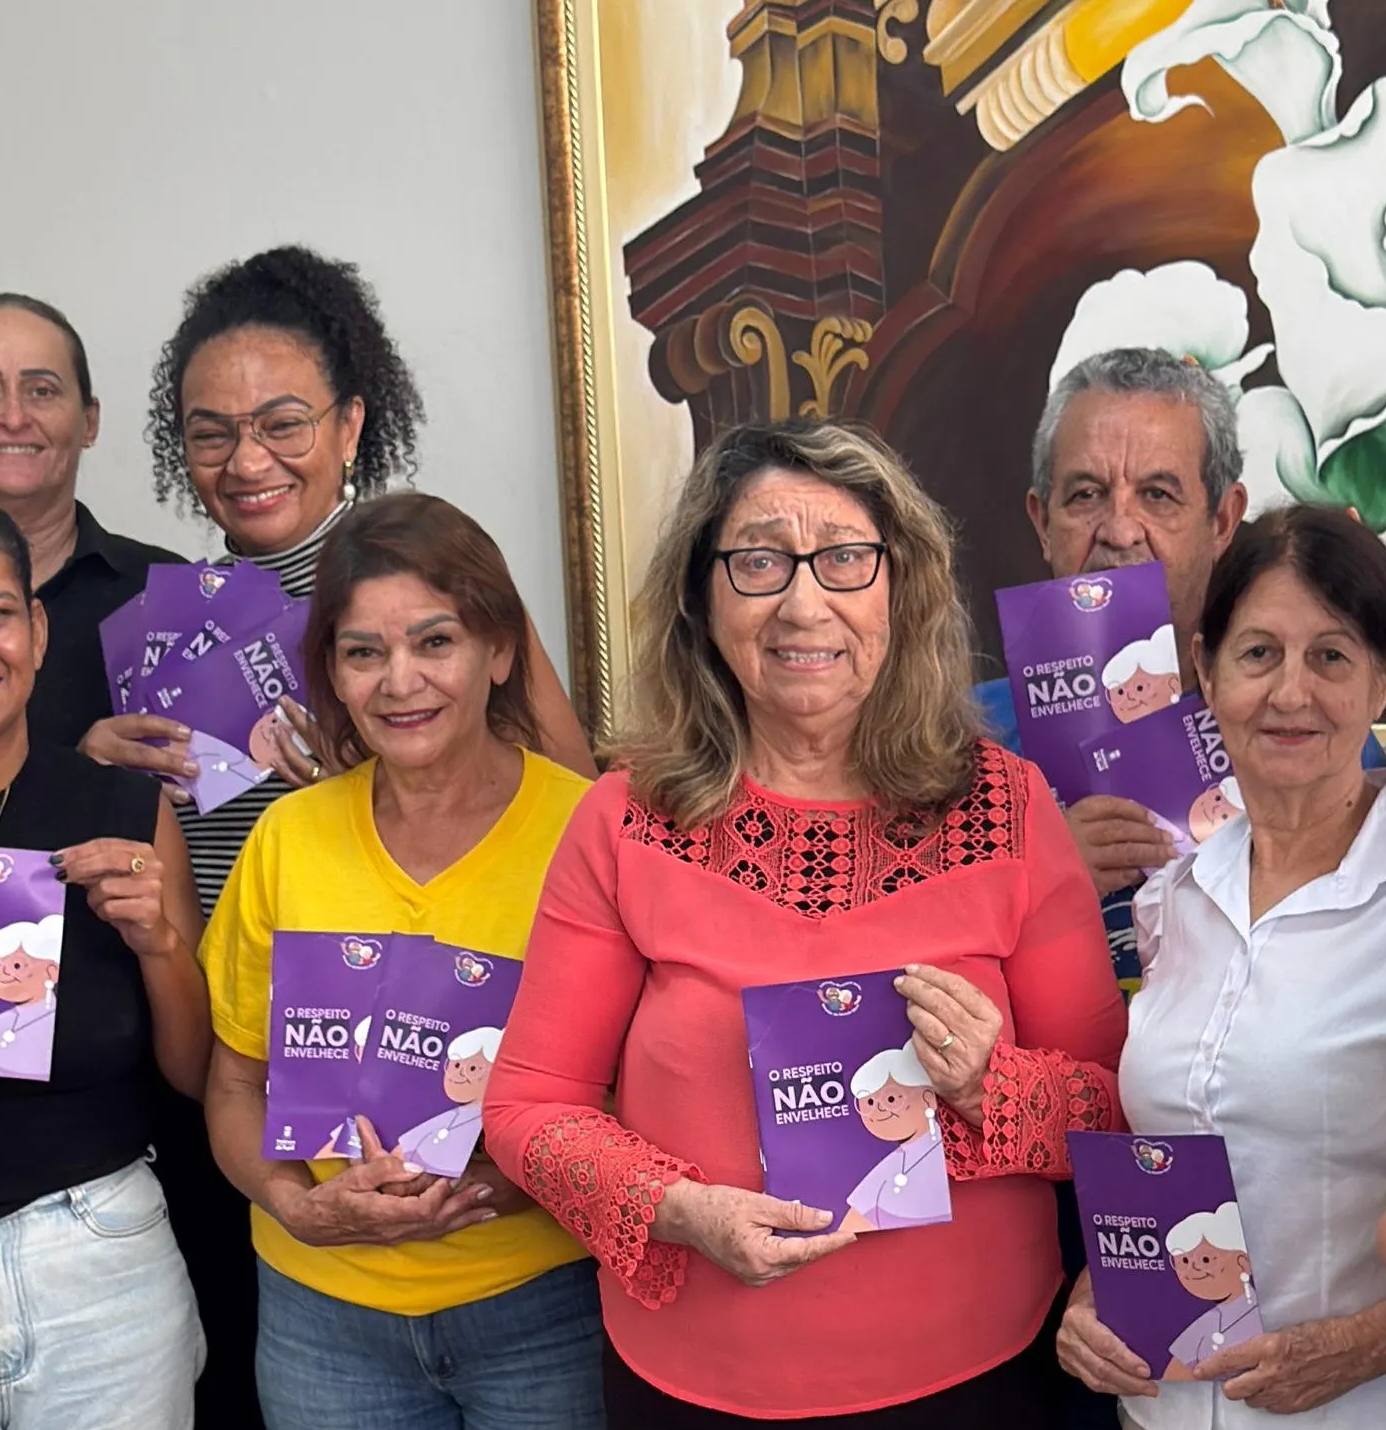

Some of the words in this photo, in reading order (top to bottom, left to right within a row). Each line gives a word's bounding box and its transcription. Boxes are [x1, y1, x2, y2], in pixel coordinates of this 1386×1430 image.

[1023, 666, 1034, 677] O
[1037, 655, 1094, 674] RESPEITO
[1027, 671, 1096, 705] NÃO
[1030, 695, 1101, 718] ENVELHECE
[1182, 714, 1212, 782] ENVELHECE
[285, 1008, 294, 1018] O
[297, 1008, 351, 1020] RESPEITO
[386, 1009, 396, 1020] O
[398, 1012, 450, 1032] RESPEITO
[285, 1019, 348, 1047] NÃO
[381, 1026, 443, 1057] NÃO
[284, 1047, 349, 1060] ENVELHECE
[377, 1050, 440, 1071] ENVELHECE
[769, 1070, 780, 1082] O
[783, 1062, 843, 1080] RESPEITO
[773, 1077, 845, 1111] NÃO
[775, 1104, 849, 1125] ENVELHECE
[1093, 1214, 1102, 1226] O
[1105, 1216, 1157, 1228] RESPEITO
[1098, 1226, 1160, 1257] NÃO
[1101, 1257, 1165, 1271] ENVELHECE
